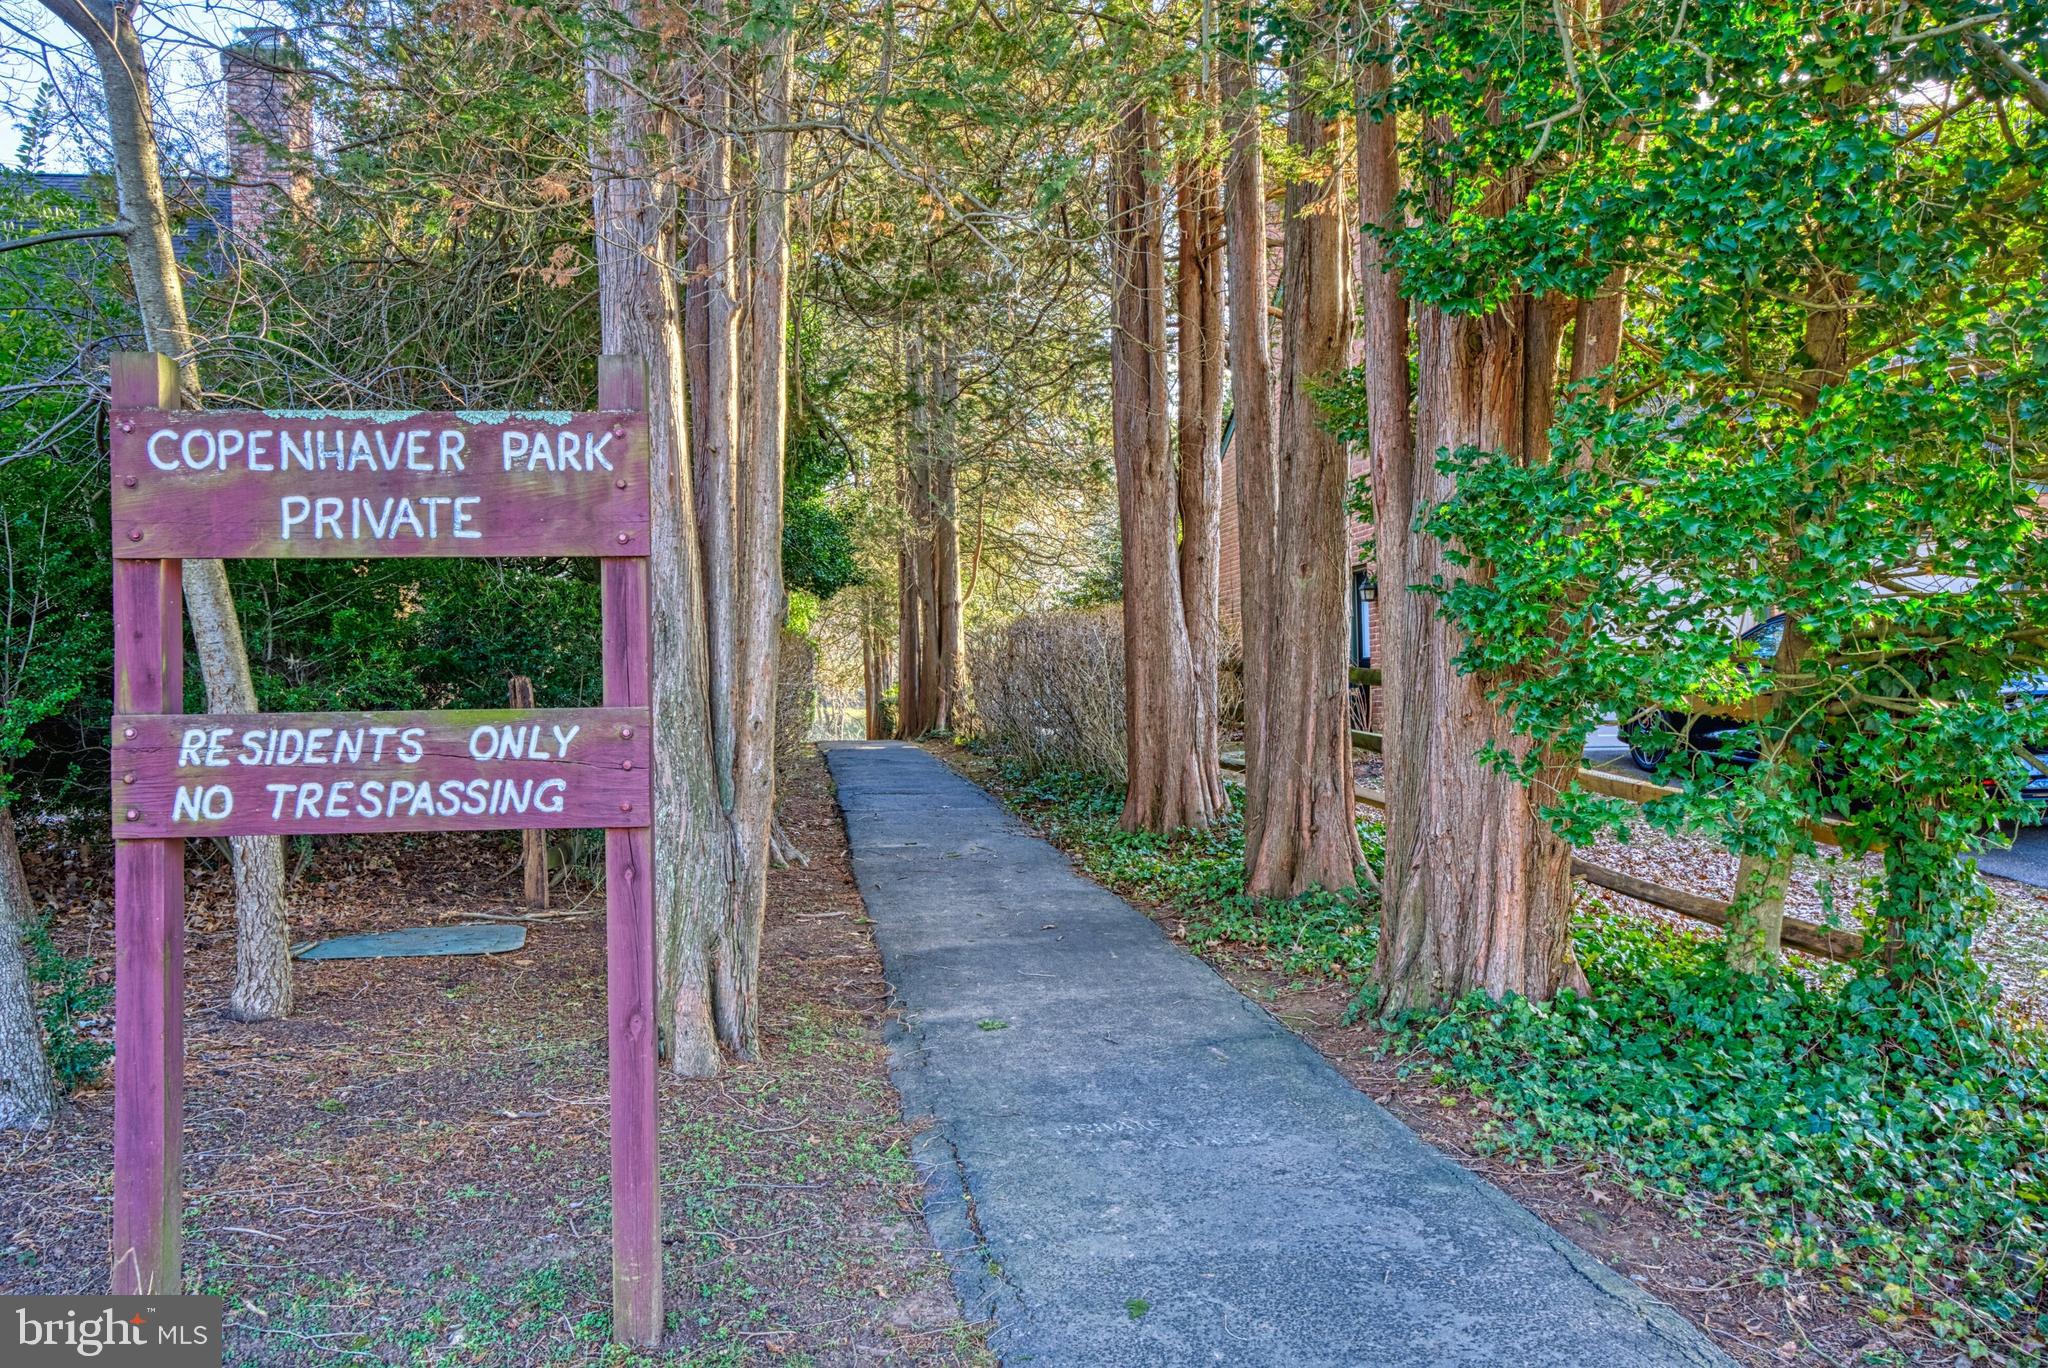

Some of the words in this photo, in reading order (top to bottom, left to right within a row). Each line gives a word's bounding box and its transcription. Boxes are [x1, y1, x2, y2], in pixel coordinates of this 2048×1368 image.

[146, 429, 466, 472] COPENHAVER
[502, 430, 614, 473] PARK
[280, 495, 483, 540] PRIVATE
[177, 726, 426, 767] RESIDENTS
[468, 724, 580, 761] ONLY
[171, 784, 233, 822] NO
[265, 777, 567, 821] TRESPASSING
